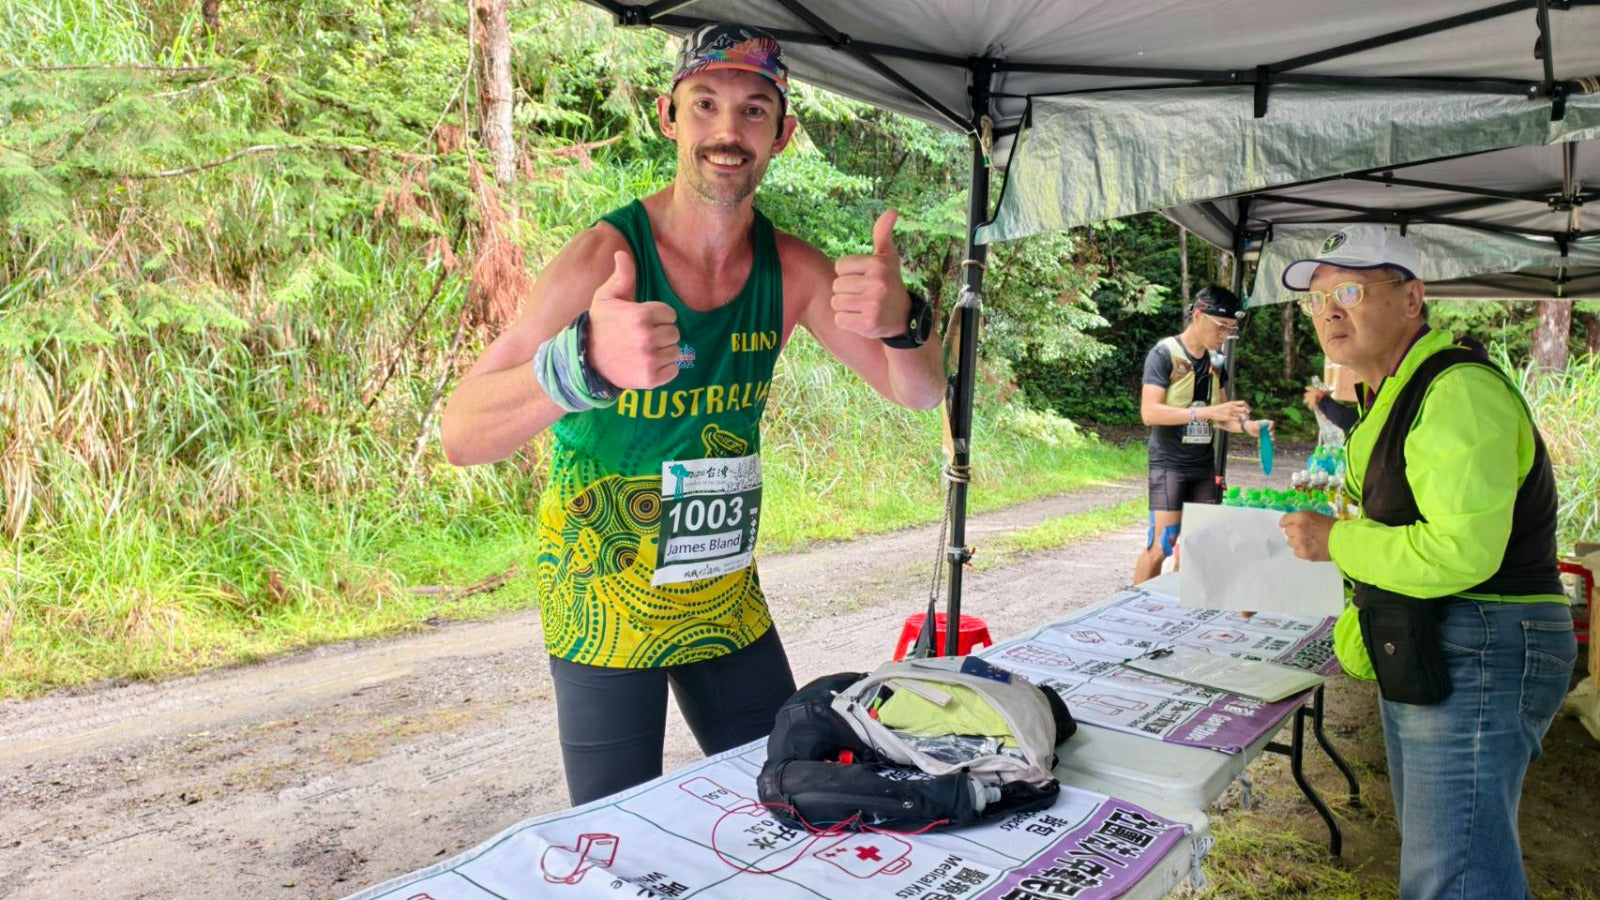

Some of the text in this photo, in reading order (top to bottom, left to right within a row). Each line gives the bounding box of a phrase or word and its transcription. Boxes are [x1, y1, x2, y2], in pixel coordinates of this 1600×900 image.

[617, 379, 771, 419] AUSTRALIA
[668, 496, 744, 534] 1003
[667, 534, 741, 556] James Bland
[743, 820, 774, 835] 0.5L
[1025, 814, 1069, 837] 背包
[896, 854, 964, 899] Medical Kits
[919, 866, 990, 900] 醫療包
